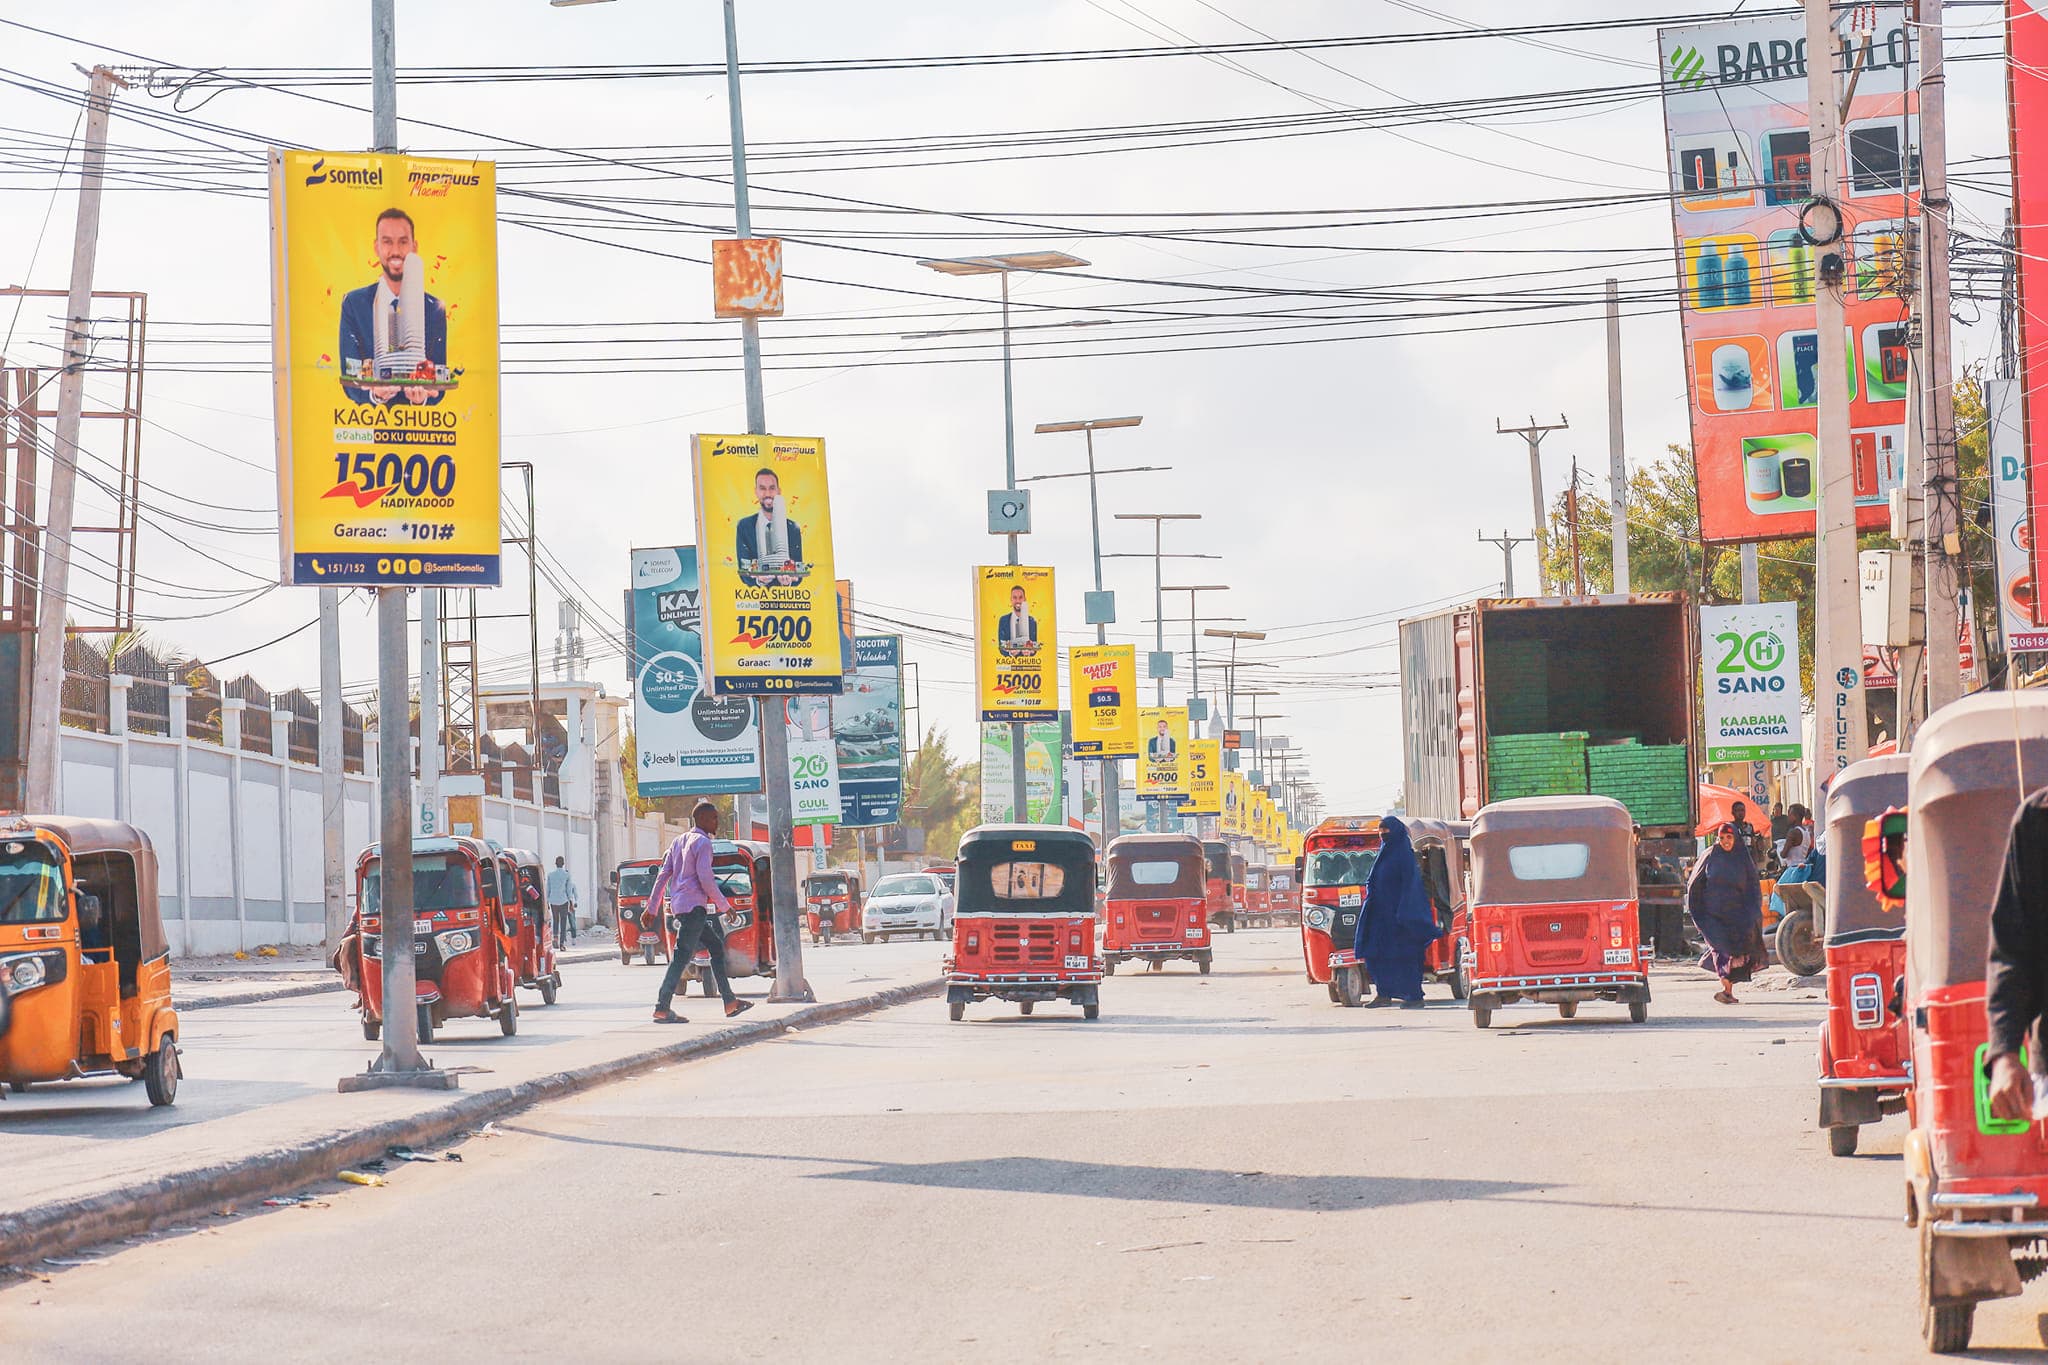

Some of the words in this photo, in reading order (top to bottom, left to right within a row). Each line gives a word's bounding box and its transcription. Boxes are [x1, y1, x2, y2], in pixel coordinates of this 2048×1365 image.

[329, 167, 382, 185] somtel
[334, 408, 389, 426] KAGA
[393, 411, 457, 428] SHUBO
[390, 432, 404, 442] KU
[405, 432, 456, 444] GUULEYSO
[726, 444, 759, 455] somtel
[334, 452, 456, 497] 15000
[380, 498, 455, 508] HADIYADOOD
[334, 523, 387, 538] Garaac:
[327, 563, 365, 574] 151/152
[735, 588, 768, 600] KAGA
[771, 589, 811, 600] SHUBO
[736, 615, 811, 642] 15000
[738, 658, 771, 667] Garaac:
[1083, 661, 1118, 674] KAAFIYE
[1091, 670, 1112, 680] PLUS
[997, 674, 1041, 690] 15000
[1718, 676, 1785, 694] SANO
[1094, 708, 1117, 717] 1.5GB
[1720, 715, 1787, 727] KAABAHA
[1720, 726, 1788, 737] GANACSIGA
[652, 753, 676, 764] Jeeb
[794, 779, 829, 790] SANO
[799, 799, 829, 809] GUUL
